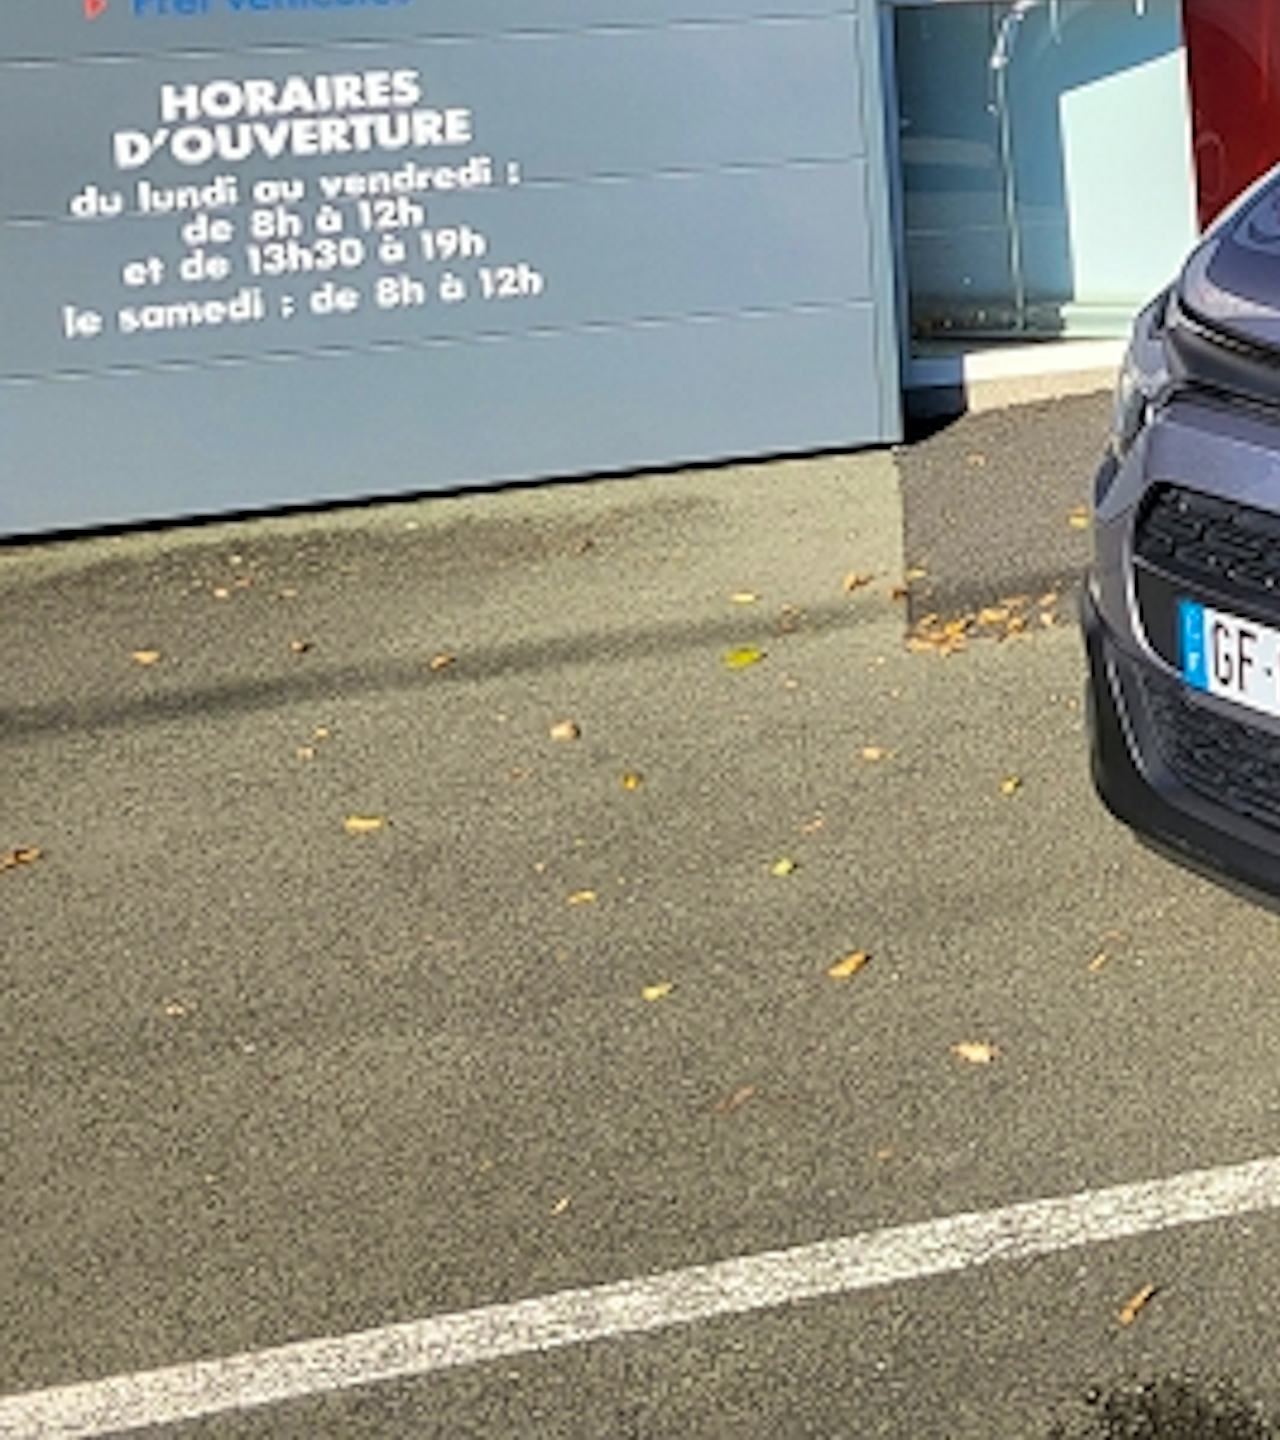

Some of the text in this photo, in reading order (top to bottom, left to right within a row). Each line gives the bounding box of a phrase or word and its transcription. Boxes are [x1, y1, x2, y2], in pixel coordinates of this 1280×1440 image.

[160, 70, 421, 122] HORAIRES
[113, 109, 473, 169] D'OUVERTURE
[71, 185, 123, 217] du
[137, 175, 239, 213] lundi
[253, 180, 304, 203] au
[320, 156, 492, 198] vendredi
[183, 197, 425, 245] de 8h à 12h
[122, 226, 488, 286] et de 13h30 à 19h
[64, 305, 103, 339] le
[118, 287, 264, 334] samedi
[310, 282, 359, 315] de
[375, 274, 426, 309] 8h
[439, 272, 466, 302] à
[479, 263, 545, 299] 12h
